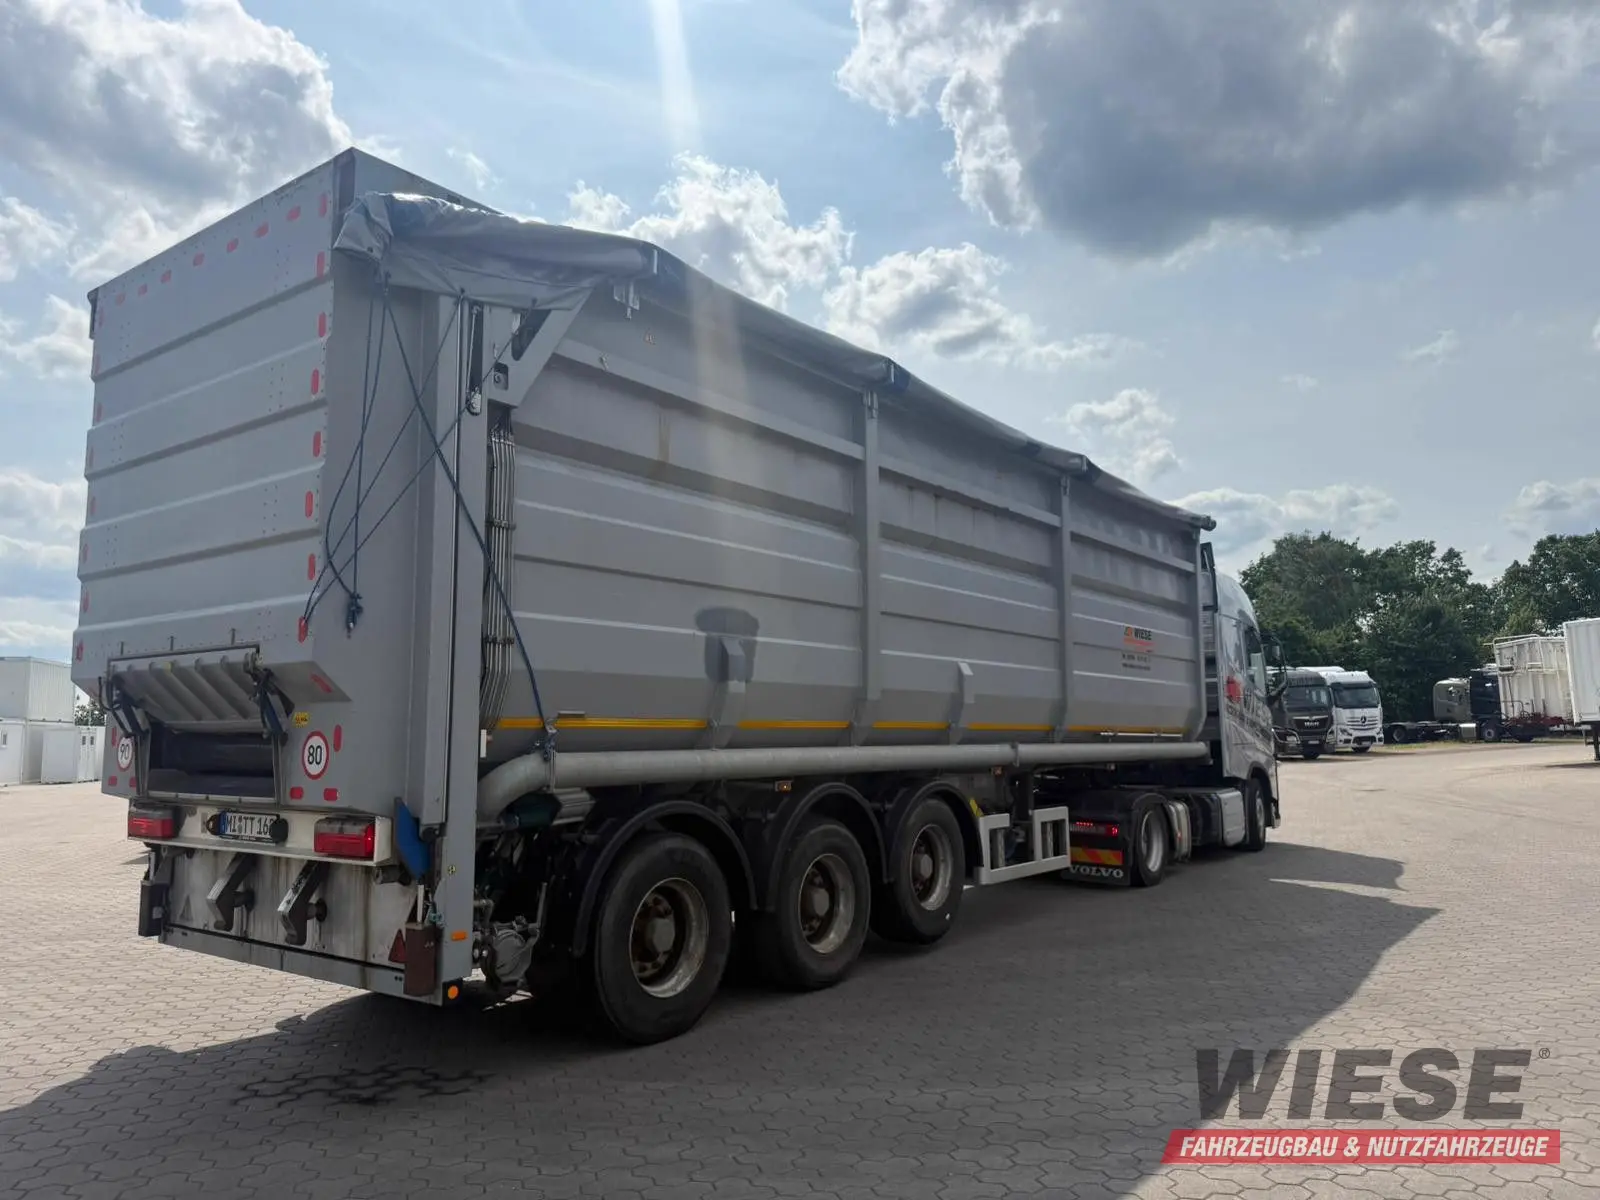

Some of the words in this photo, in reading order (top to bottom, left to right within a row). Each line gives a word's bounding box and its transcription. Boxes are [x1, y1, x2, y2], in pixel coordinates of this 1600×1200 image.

[307, 744, 323, 765] 80
[243, 815, 255, 835] TT
[1069, 864, 1124, 878] VOLVO
